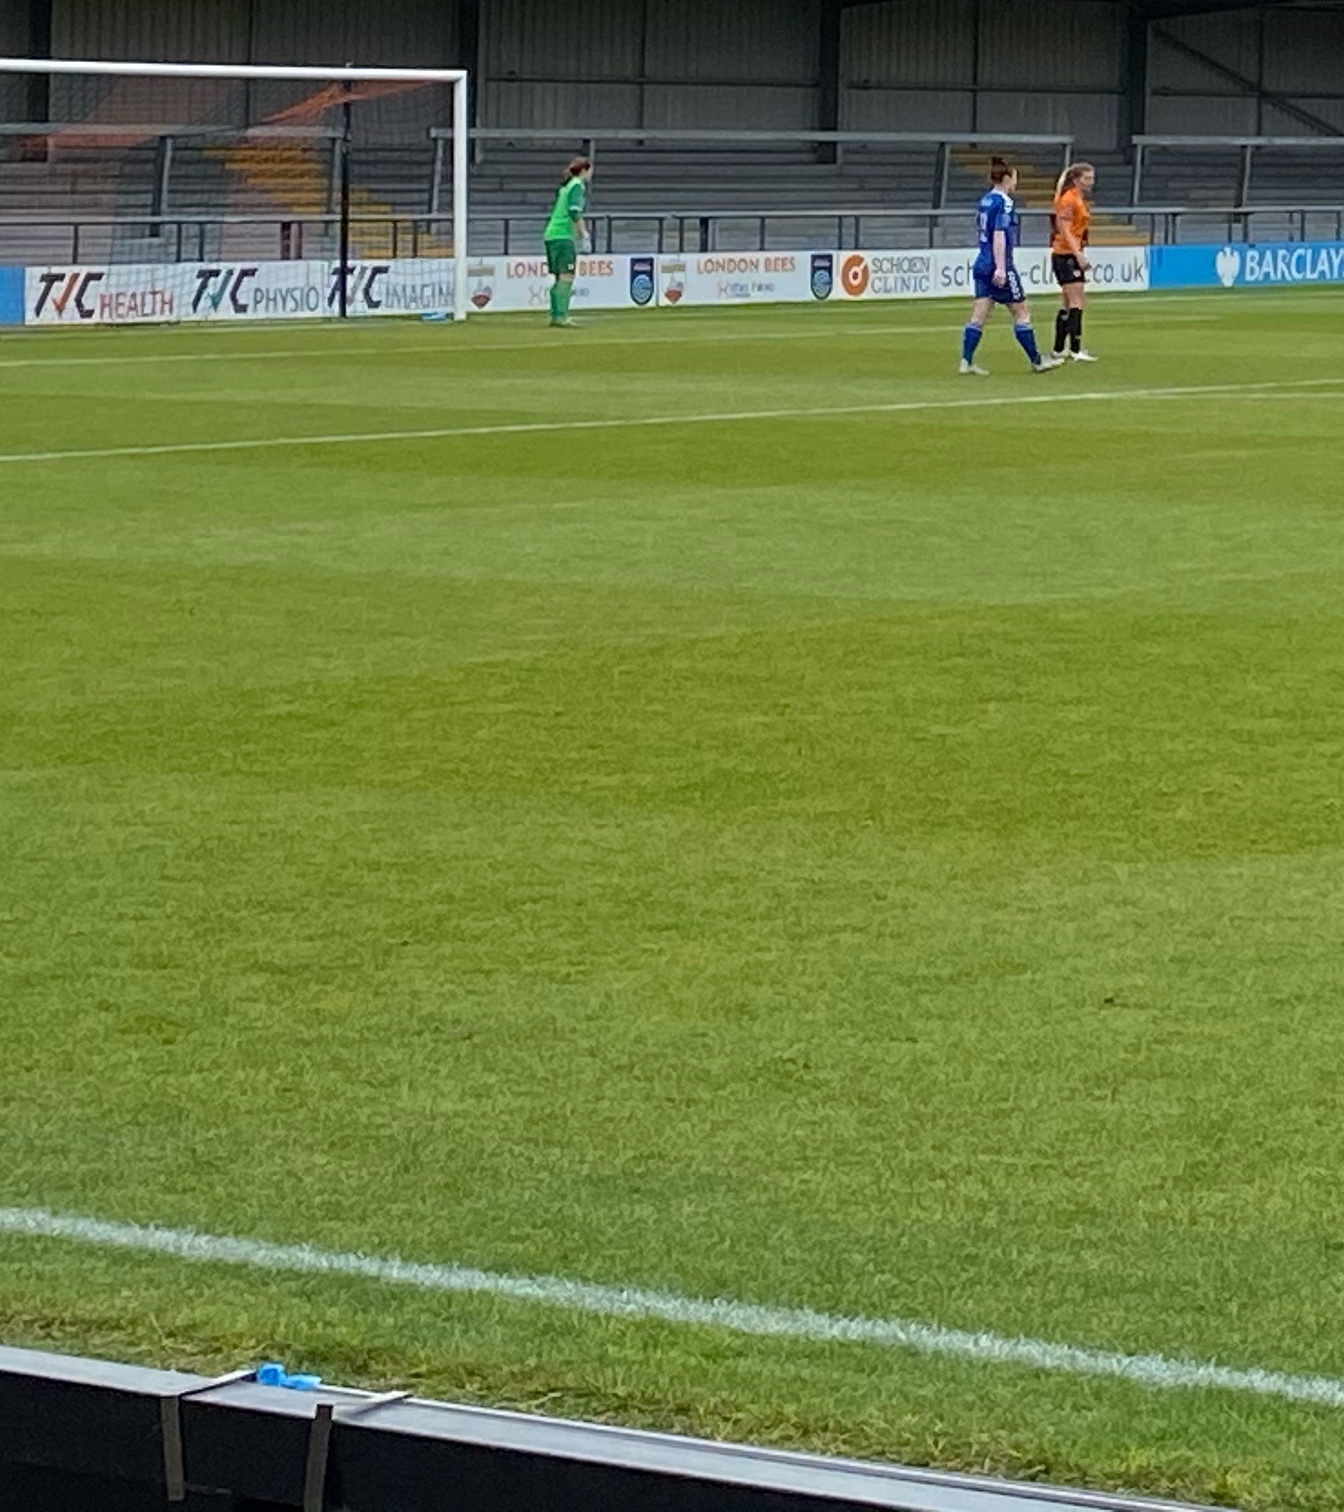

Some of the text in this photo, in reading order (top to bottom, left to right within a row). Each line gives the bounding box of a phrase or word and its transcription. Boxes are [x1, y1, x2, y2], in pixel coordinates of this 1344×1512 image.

[579, 260, 614, 277] BEES
[697, 258, 760, 275] LONDON
[764, 257, 796, 272] BEES
[871, 256, 930, 276] SCHOEN
[871, 273, 930, 294] CLINIC
[100, 290, 174, 319] HEALTH
[253, 287, 319, 313] PHYSIO
[384, 282, 454, 309] IMAGIN
